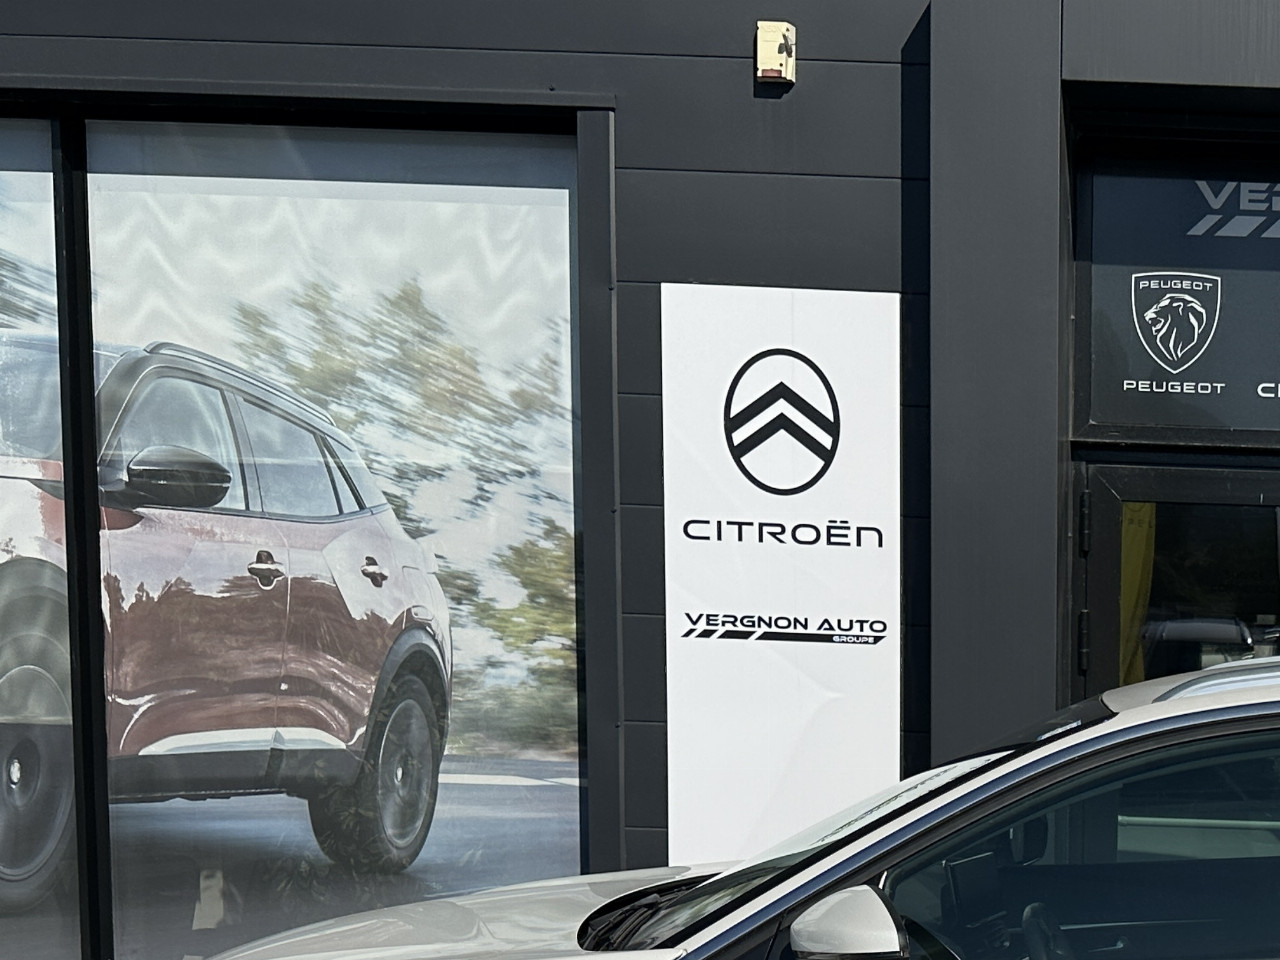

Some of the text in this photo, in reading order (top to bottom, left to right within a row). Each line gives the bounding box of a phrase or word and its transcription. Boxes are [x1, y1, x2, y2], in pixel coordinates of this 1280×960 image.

[1139, 280, 1213, 291] PEUGEOT
[1123, 379, 1226, 394] PEUGEOT
[684, 612, 888, 634] VERGNON AUTO
[832, 635, 875, 644] GROUPE
